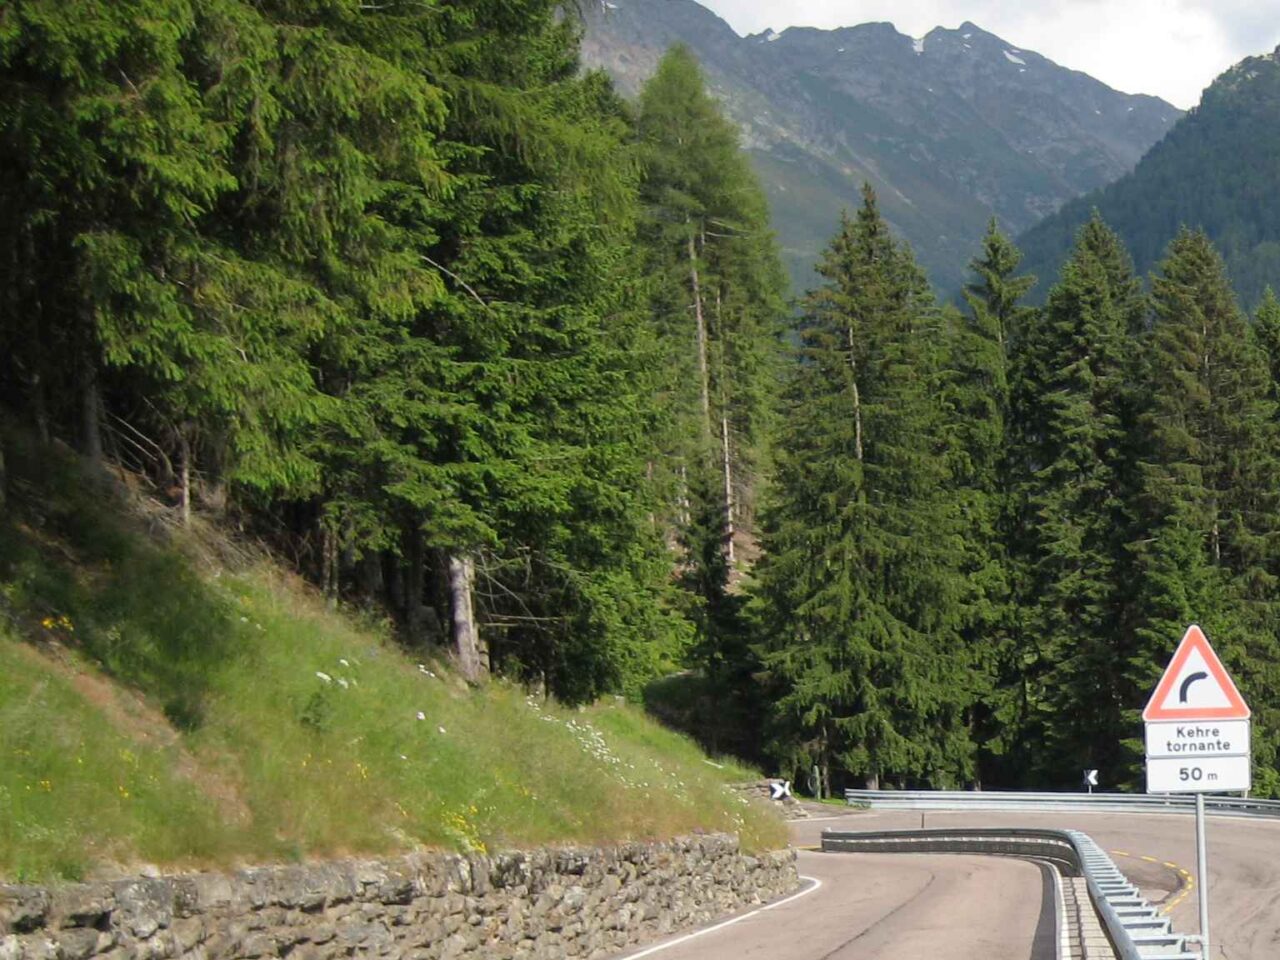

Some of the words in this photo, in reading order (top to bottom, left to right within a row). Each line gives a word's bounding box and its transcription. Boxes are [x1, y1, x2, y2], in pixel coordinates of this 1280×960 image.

[1176, 726, 1220, 738] Kehre
[1166, 740, 1231, 752] tornante
[1179, 766, 1203, 781] 50
[1207, 772, 1218, 781] m
